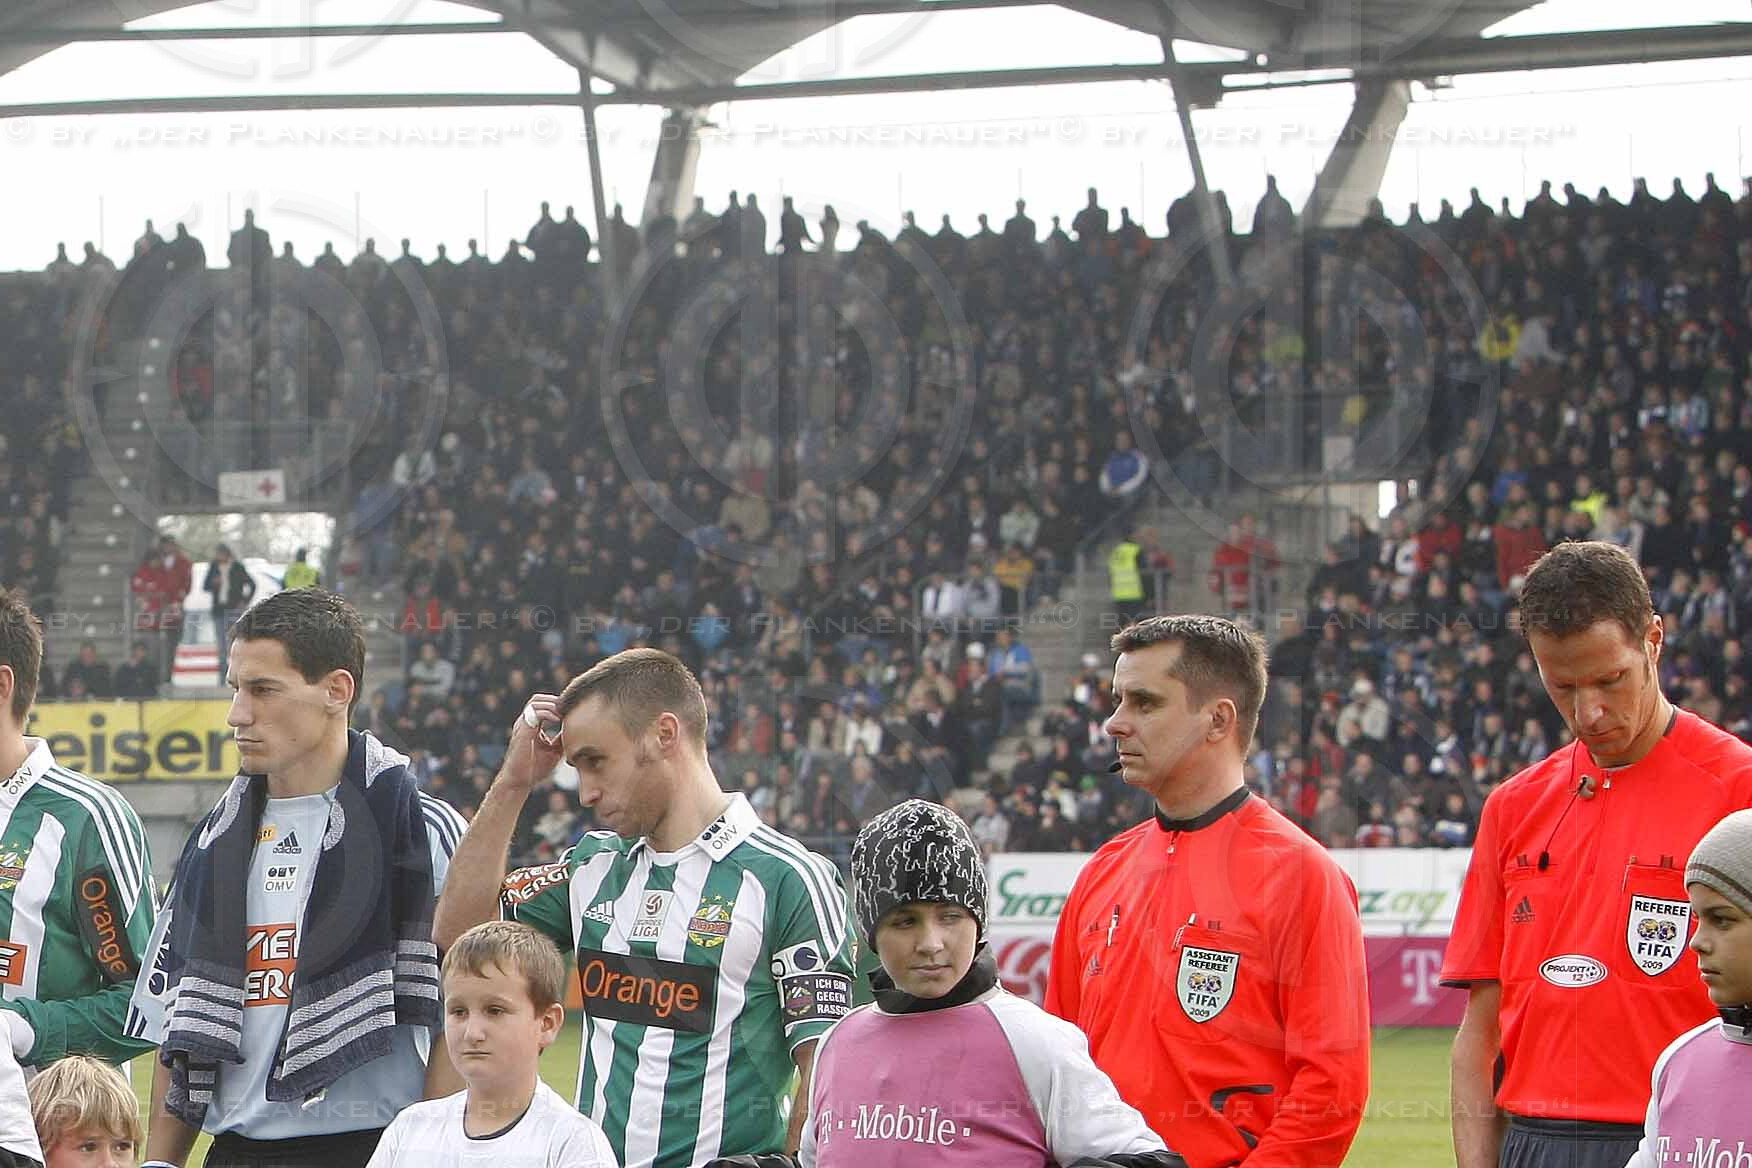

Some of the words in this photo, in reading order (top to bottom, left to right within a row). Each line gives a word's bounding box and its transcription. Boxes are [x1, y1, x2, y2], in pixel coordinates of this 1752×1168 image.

[9, 767, 33, 795] OMV
[713, 825, 737, 850] OMV
[265, 881, 294, 891] OMV
[1635, 901, 1688, 916] REFEREE
[82, 878, 127, 975] Orange
[632, 926, 659, 937] LIGA
[1186, 949, 1235, 963] ASSISTANT
[1637, 942, 1676, 958] FIFA
[1188, 959, 1228, 973] REFEREE
[1642, 960, 1663, 970] 2009
[583, 960, 699, 1018] Orange
[815, 979, 831, 988] ICH
[1187, 993, 1220, 1008] FIFA
